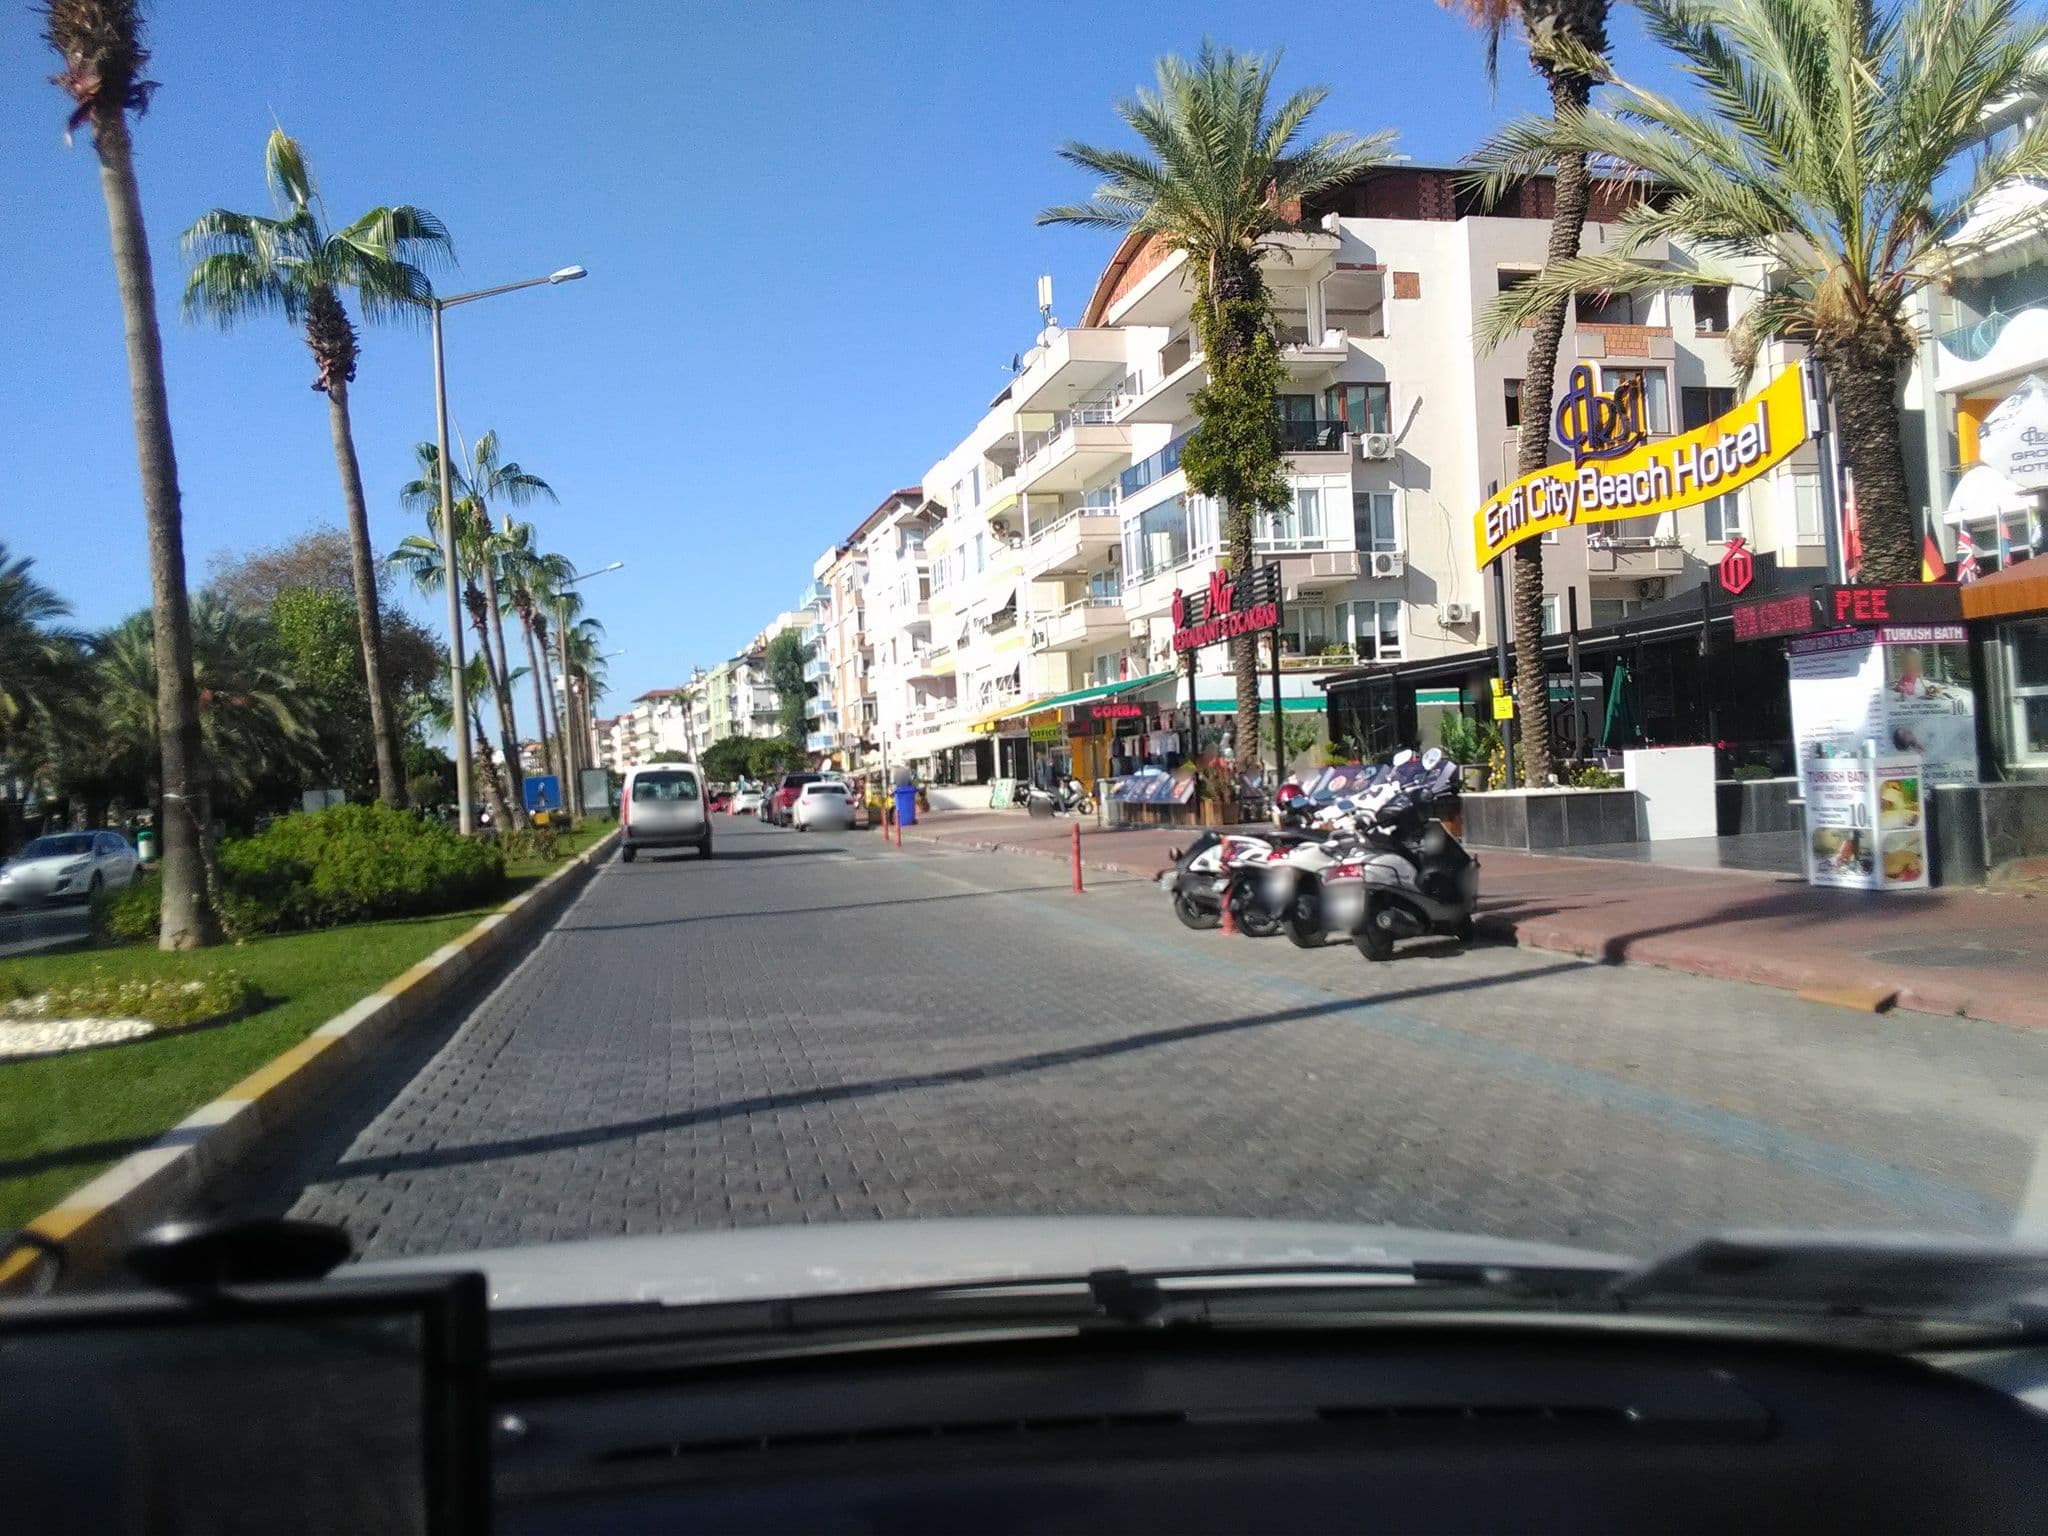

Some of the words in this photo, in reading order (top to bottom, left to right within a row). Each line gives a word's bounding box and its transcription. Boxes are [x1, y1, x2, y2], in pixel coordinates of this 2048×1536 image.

[1485, 485, 1528, 548] Enfi
[1527, 474, 1580, 525] City
[1579, 457, 1672, 512] Beach
[1673, 400, 1772, 496] Hotel
[1834, 589, 1890, 620] PEE
[1882, 627, 1932, 641] TURKISH
[1933, 626, 1963, 640] BATH
